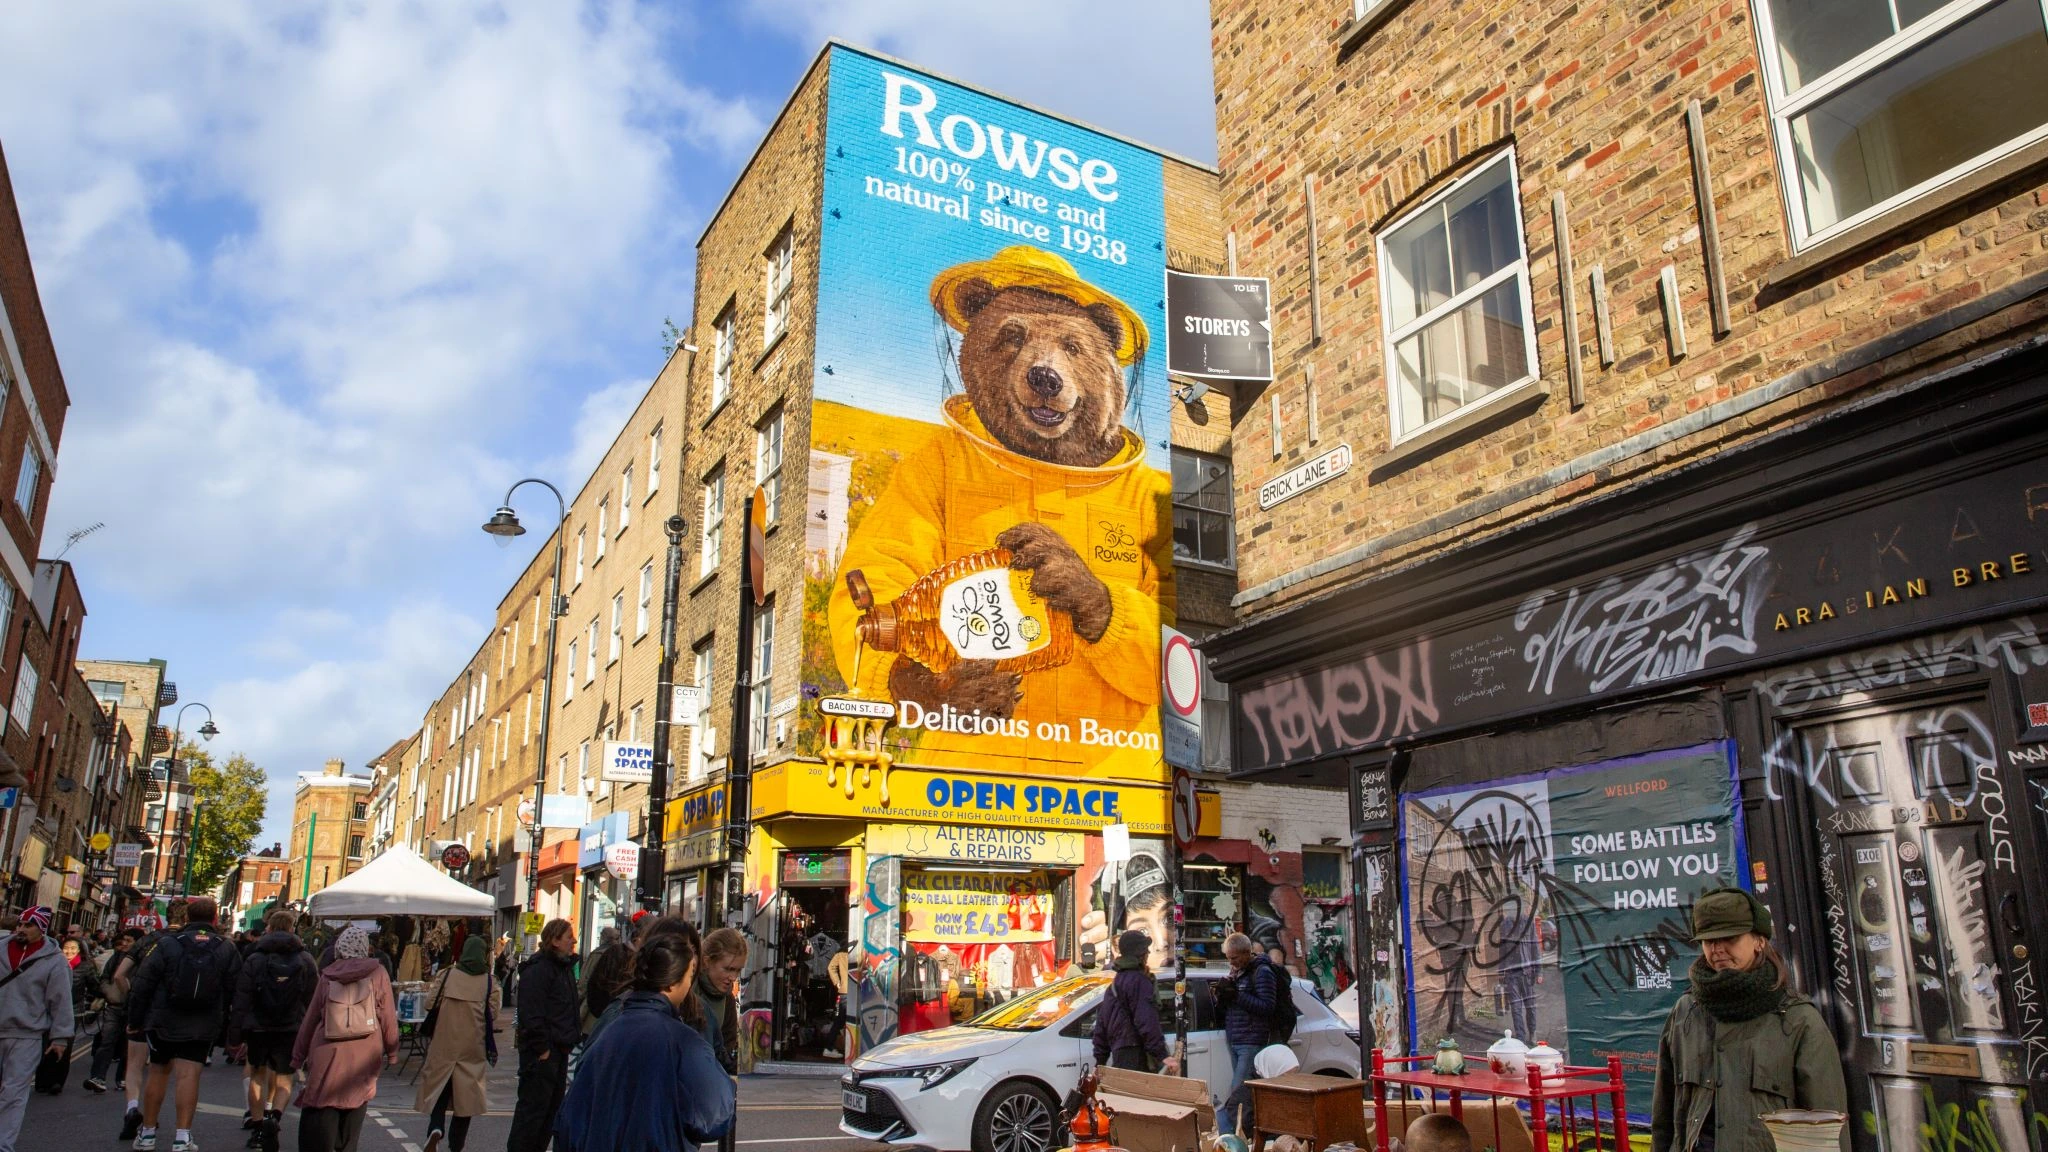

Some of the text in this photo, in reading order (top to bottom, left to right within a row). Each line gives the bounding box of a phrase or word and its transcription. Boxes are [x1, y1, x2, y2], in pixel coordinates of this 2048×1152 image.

[894, 146, 1106, 232] 100% pure and
[864, 175, 1127, 266] natural since 1938
[1233, 284, 1260, 293] TO LET
[1184, 315, 1250, 337] STOREYS
[1262, 476, 1293, 504] BRICK
[1296, 459, 1327, 488] LANE
[1094, 545, 1137, 563] Rowse
[676, 688, 699, 697] CCTV
[828, 701, 889, 715] BACON ST. E.2.
[898, 700, 1160, 751] Delicious on Bacon
[618, 746, 652, 758] OPEN
[926, 777, 1119, 818] OPEN SPACE
[1604, 778, 1668, 798] WELLFORD
[683, 793, 709, 825] OPEN
[862, 806, 1172, 831] MANUFACTURER OF HIGH QUALITY LEATHER GARMENTS CCESSORIES
[936, 824, 1046, 846] ALTERATIONS
[1571, 821, 1717, 856] SOME BATTLES
[616, 848, 637, 856] FREE
[949, 842, 1032, 861] & REPAIRS
[1573, 852, 1719, 884] FOLLOW YOU
[926, 893, 953, 905] REAL
[956, 894, 999, 906] LEATHER
[1614, 887, 1679, 911] HOME
[935, 912, 963, 924] NOW
[964, 911, 1009, 936] £45
[934, 924, 963, 936] ONLY
